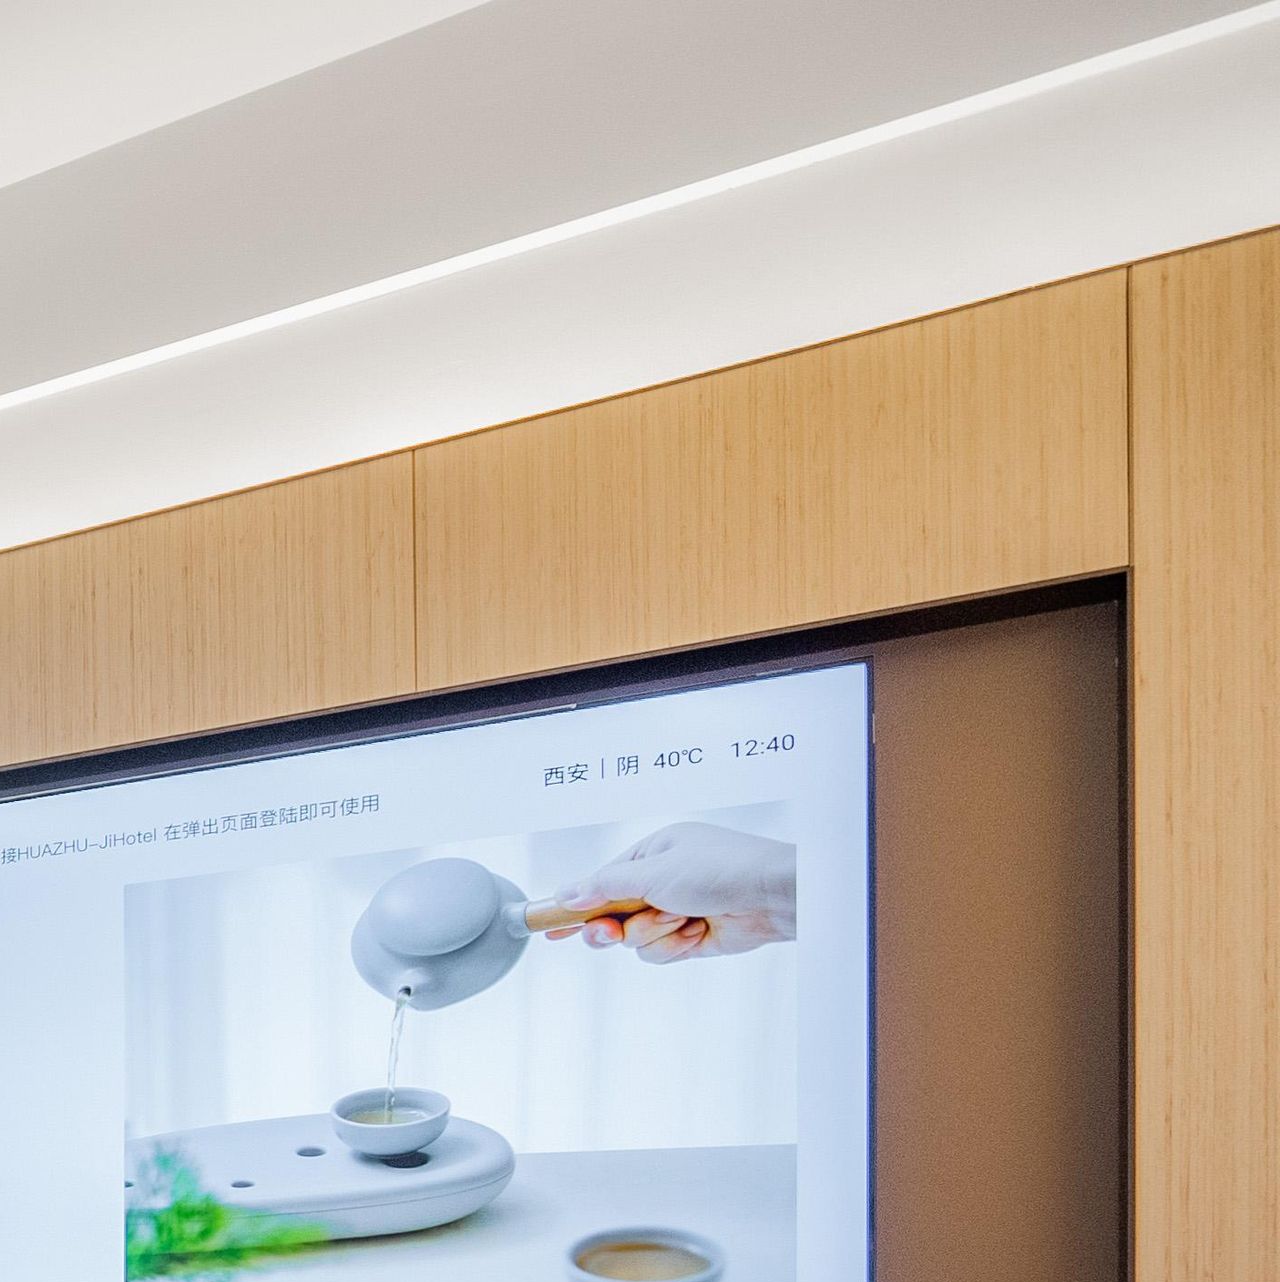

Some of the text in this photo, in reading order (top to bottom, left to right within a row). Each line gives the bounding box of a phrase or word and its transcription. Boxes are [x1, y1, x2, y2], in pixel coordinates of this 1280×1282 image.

[730, 733, 795, 759] 12:40
[543, 761, 589, 787] 西安
[616, 754, 639, 777] 阴
[163, 793, 380, 842] 在弹出页面登陆即可使用
